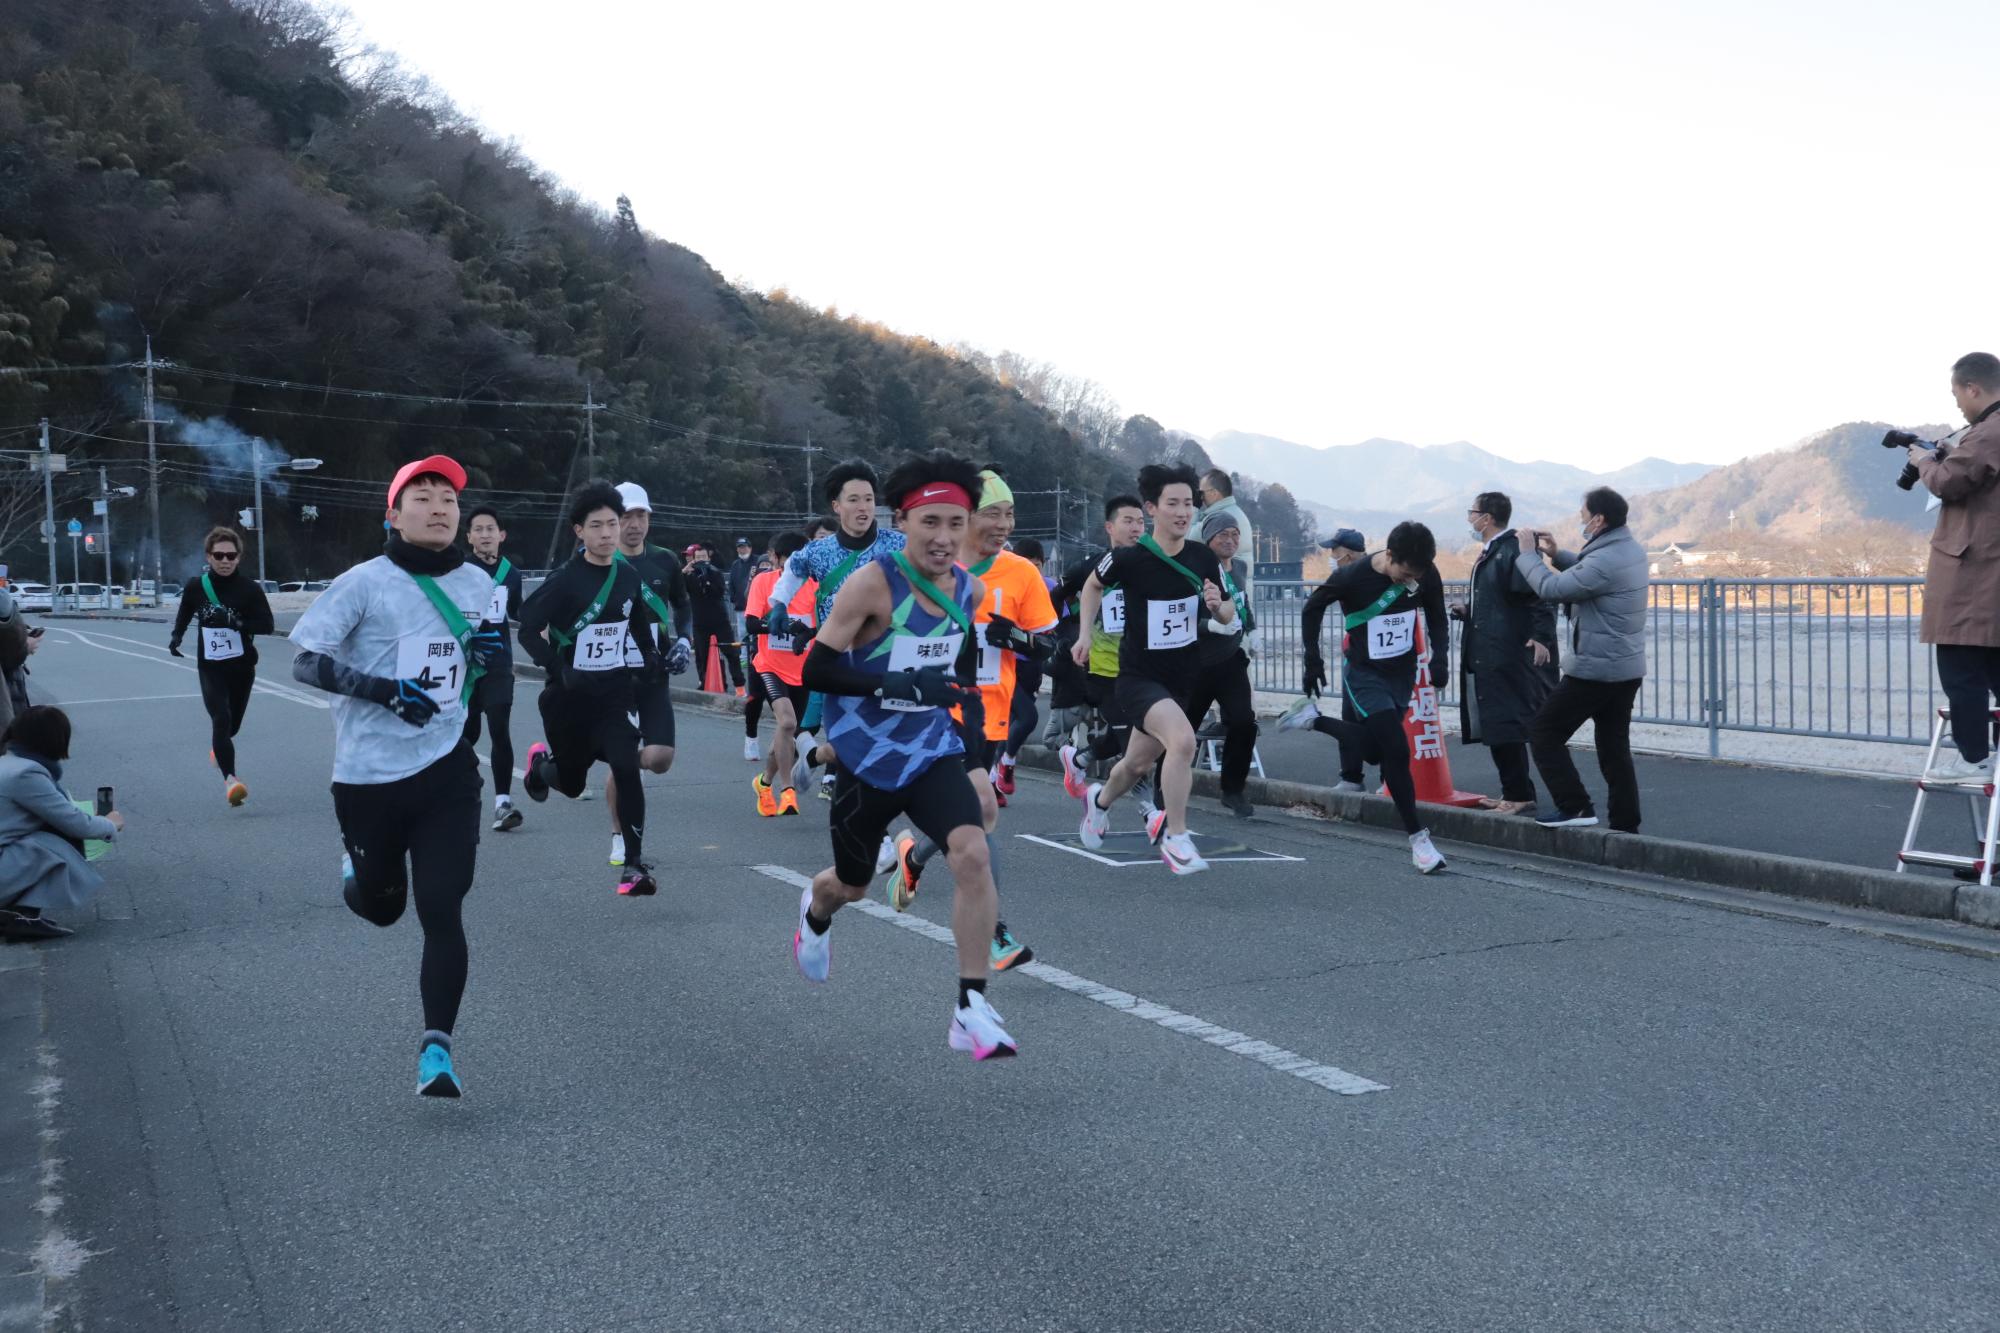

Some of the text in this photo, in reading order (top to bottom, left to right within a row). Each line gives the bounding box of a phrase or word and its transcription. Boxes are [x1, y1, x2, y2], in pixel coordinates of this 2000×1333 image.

[594, 626, 618, 637] 味間B
[1162, 616, 1189, 637] 5-1
[210, 640, 232, 652] 9-1
[1376, 628, 1409, 648] 12-1
[428, 642, 455, 658] 岡野
[585, 640, 620, 659] 15-1
[917, 643, 950, 659] 味間A
[418, 664, 458, 690] 4-1
